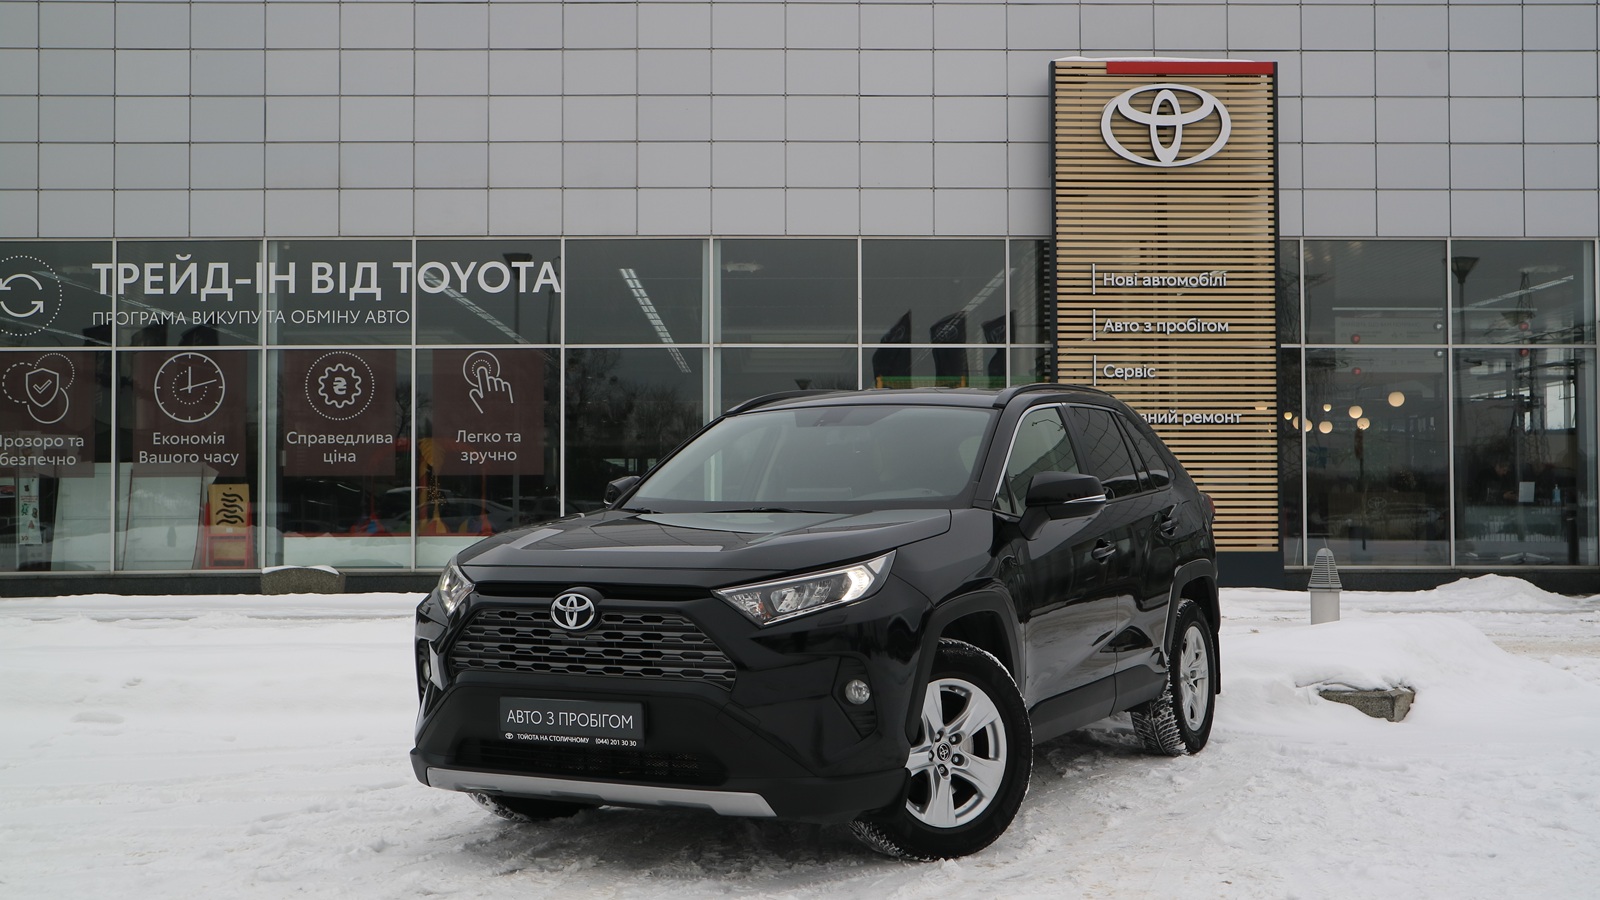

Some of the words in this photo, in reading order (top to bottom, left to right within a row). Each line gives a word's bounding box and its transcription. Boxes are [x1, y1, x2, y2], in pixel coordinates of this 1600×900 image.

[91, 253, 296, 302] ТРЕЙД-ІН
[311, 261, 382, 301] ВІД
[392, 261, 562, 294] TOYOTA
[1103, 272, 1138, 287] Нові
[1142, 272, 1227, 288] автомобілі
[92, 311, 187, 326] ПРОГРАМА
[192, 310, 262, 325] ВИКУПУ
[266, 309, 286, 324] ТА
[291, 308, 361, 324] ОБМІНУ
[364, 308, 410, 324] АВТО
[1103, 318, 1140, 333] Авто
[1143, 322, 1152, 333] з
[1156, 317, 1229, 335] пробігом
[1103, 364, 1156, 381] Сервіс
[1182, 412, 1242, 427] ремонт
[0, 434, 64, 451] розоро
[68, 437, 85, 447] та
[152, 432, 226, 445] Економія
[286, 431, 394, 445] Справедлива
[455, 430, 502, 443] Легко
[505, 433, 522, 443] та
[0, 452, 77, 466] безпечно
[139, 451, 200, 464] Вашого
[204, 453, 240, 466] часу
[323, 450, 357, 464] ціна
[460, 451, 518, 464] зручно
[506, 709, 543, 725] АВТО
[558, 712, 633, 730] ПРОБІГОМ
[516, 733, 540, 741] ТОЙОТА
[549, 735, 590, 744] СТОЛИЧНОМУ
[595, 737, 610, 746] (044)
[610, 738, 620, 746] 201
